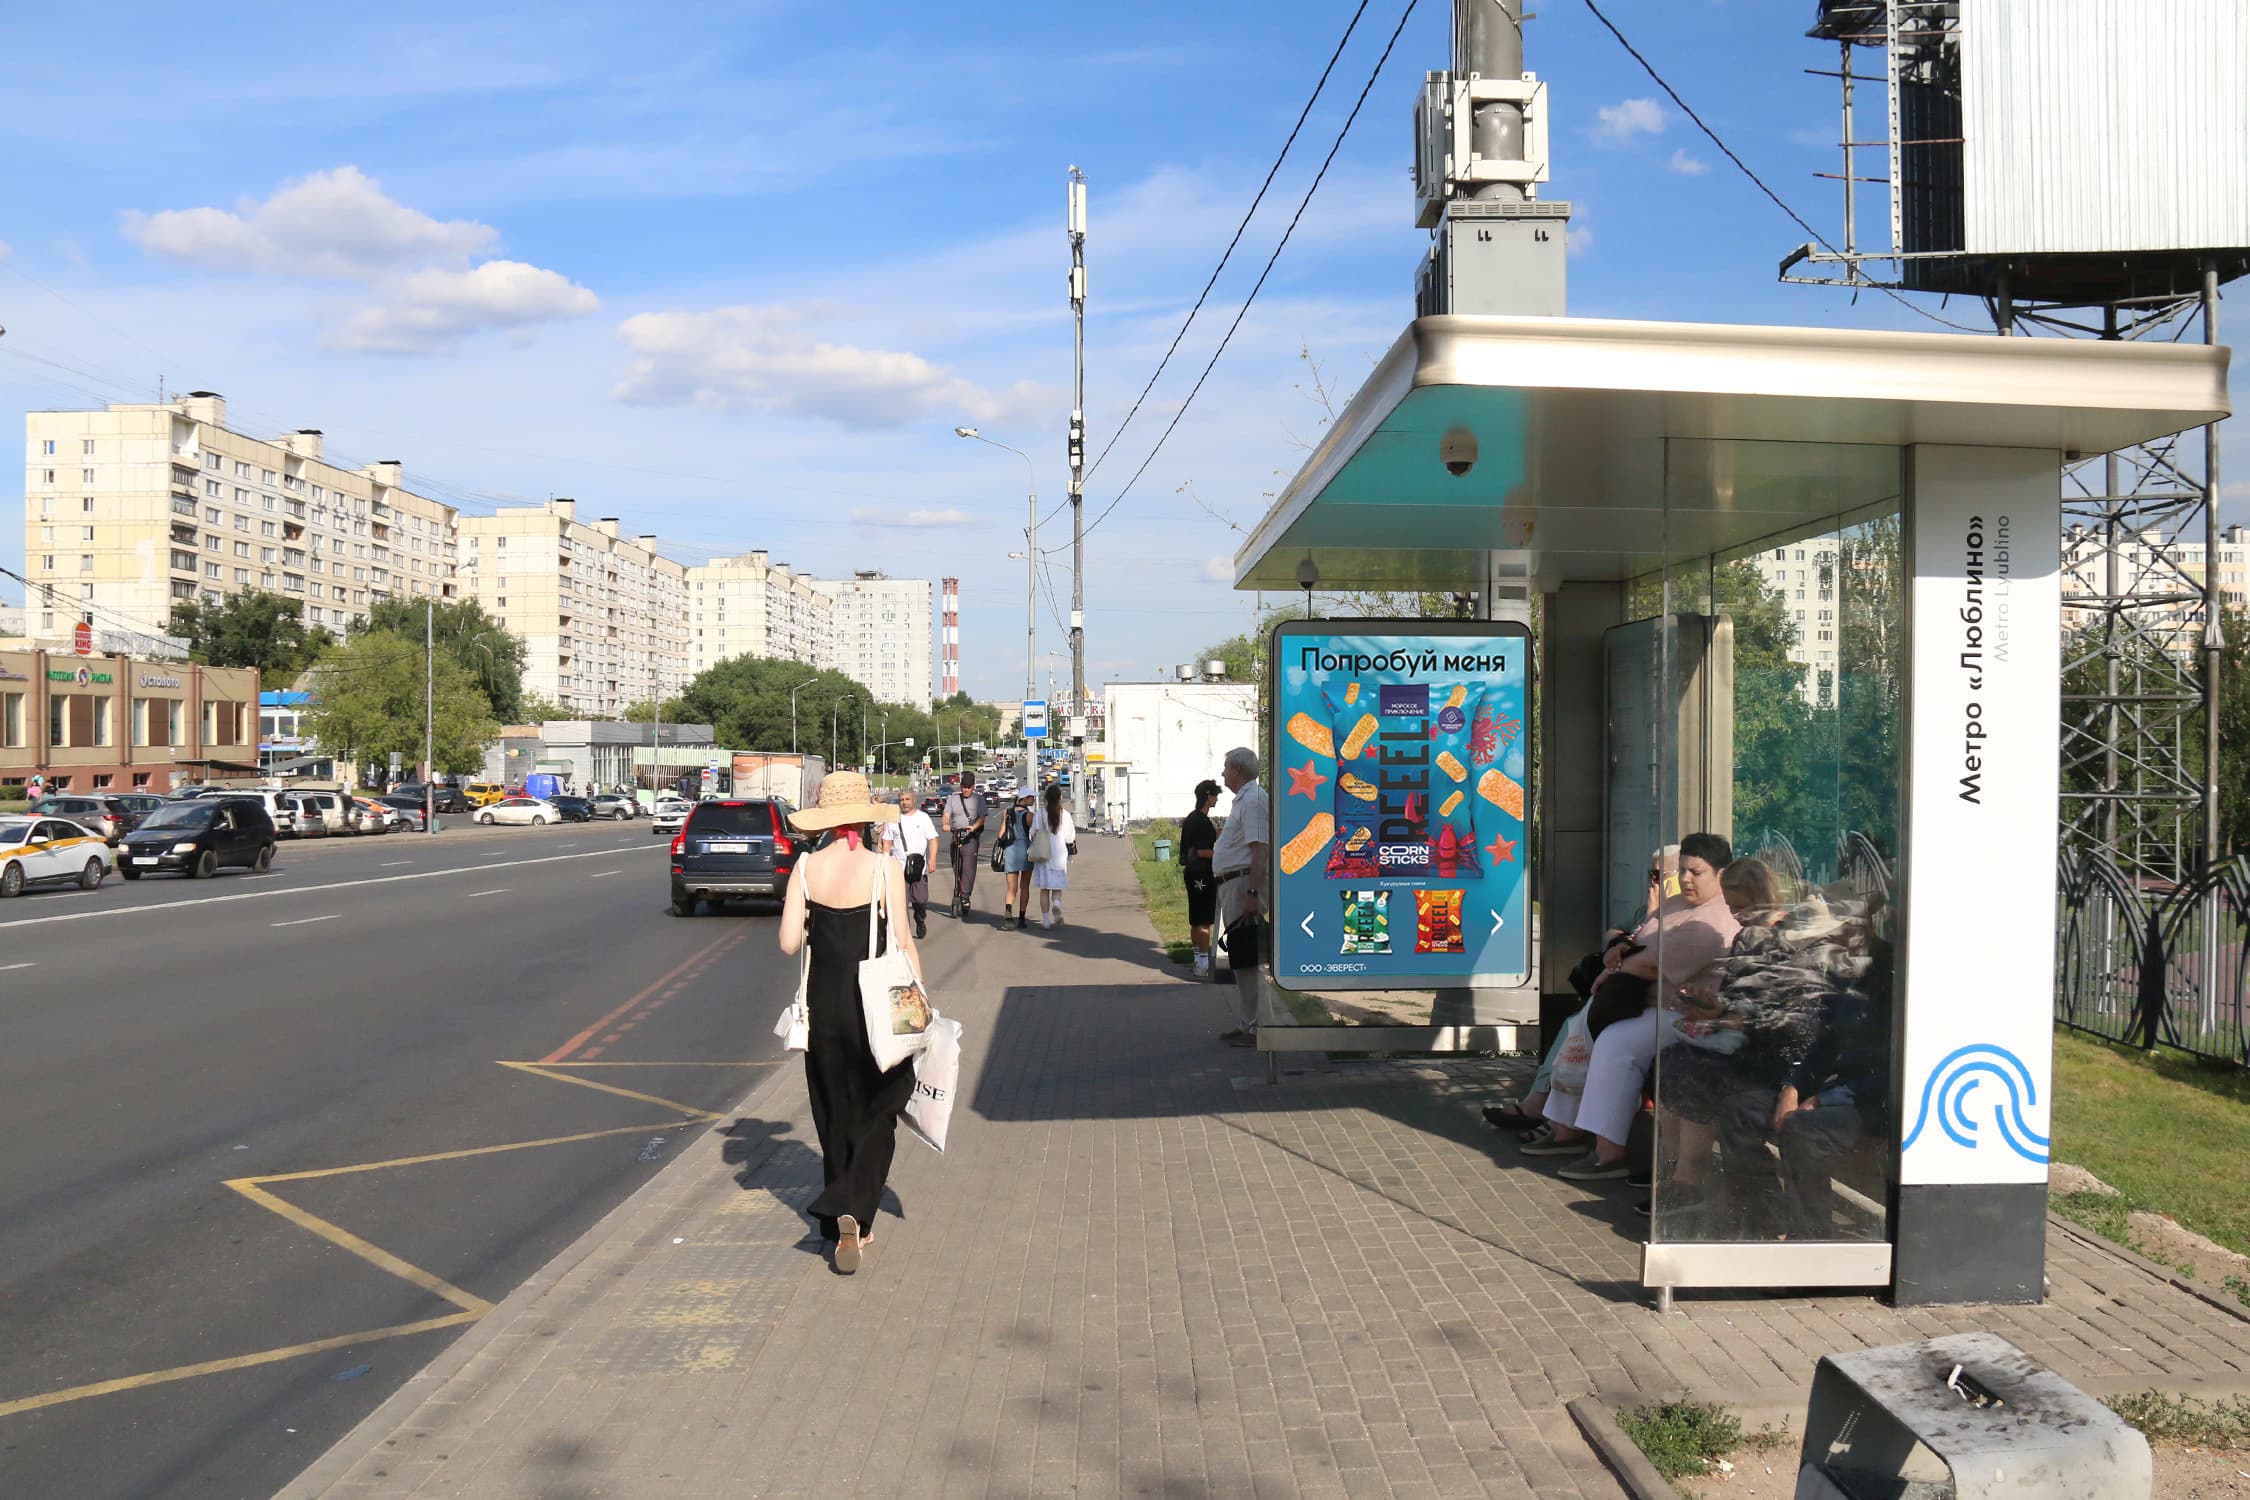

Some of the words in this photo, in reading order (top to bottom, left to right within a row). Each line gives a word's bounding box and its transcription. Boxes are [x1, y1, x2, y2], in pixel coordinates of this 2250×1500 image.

[1993, 515, 2012, 596] Lyublino
[1960, 515, 1984, 691] «Люблино»
[75, 639, 91, 649] KING
[1994, 603, 2009, 662] Metro
[1301, 647, 1437, 677] Попробуй
[1443, 655, 1506, 672] меня
[1959, 702, 1987, 804] Метро
[1379, 845, 1430, 855] CORN
[1379, 855, 1430, 865] STICKS
[1299, 963, 1323, 973] ООО
